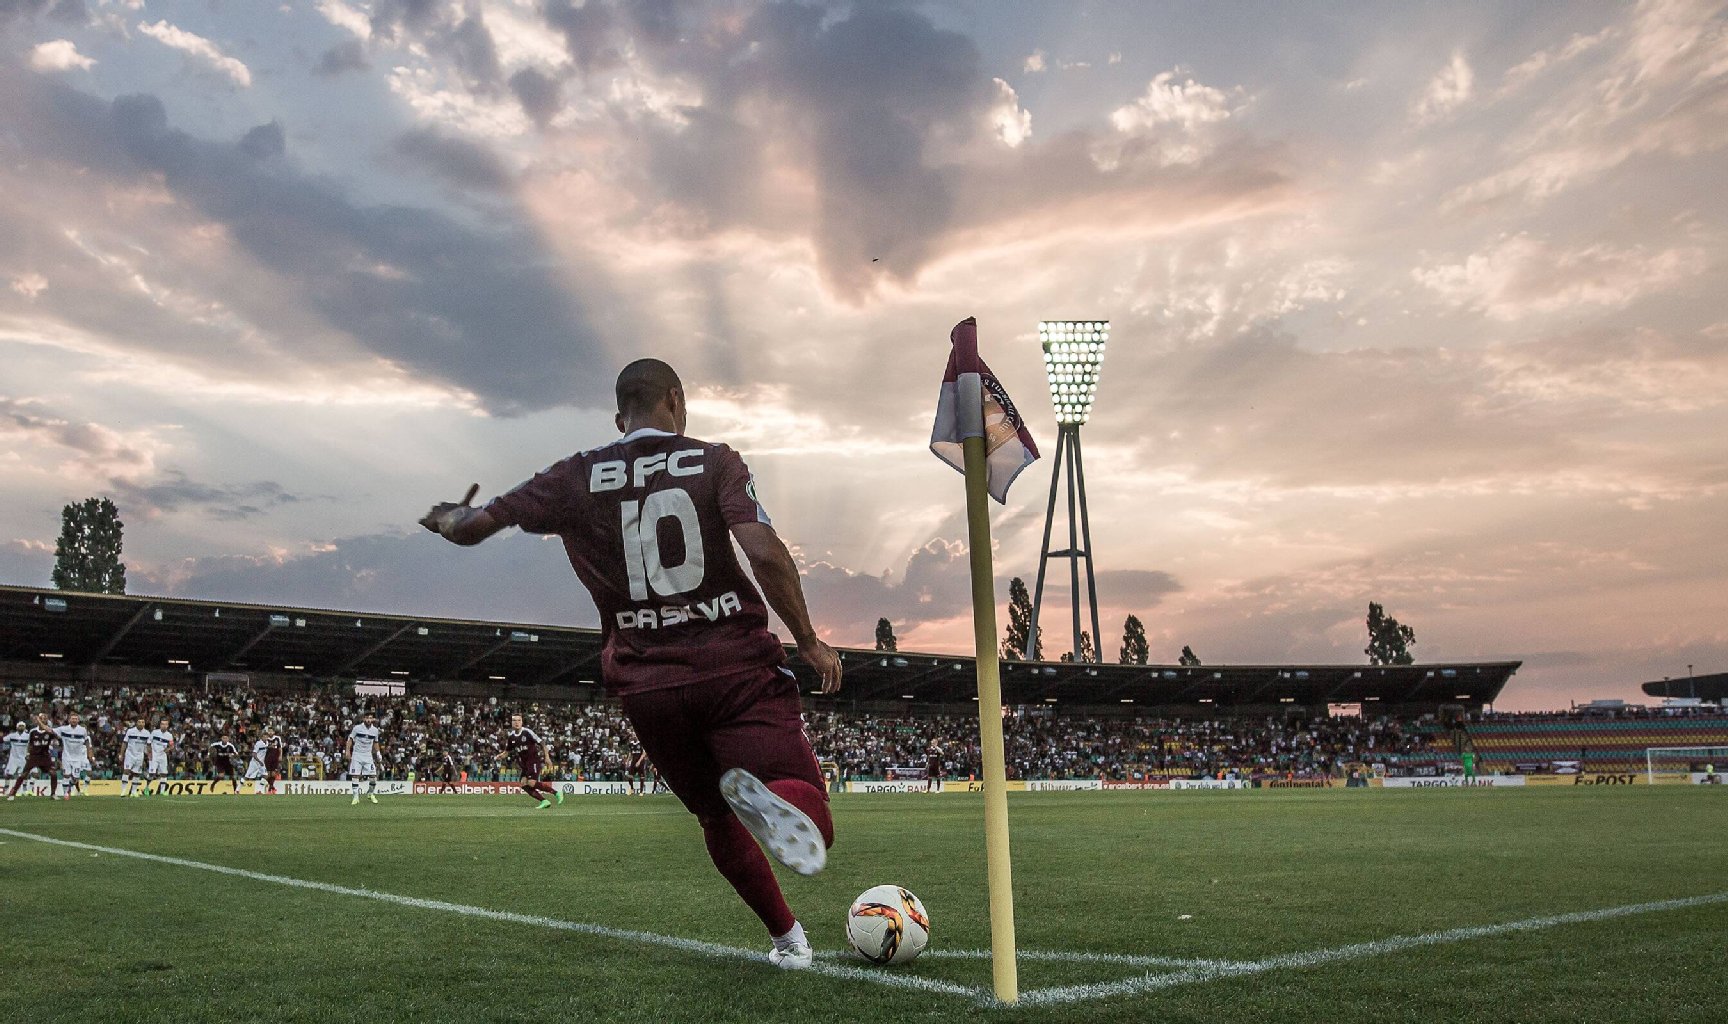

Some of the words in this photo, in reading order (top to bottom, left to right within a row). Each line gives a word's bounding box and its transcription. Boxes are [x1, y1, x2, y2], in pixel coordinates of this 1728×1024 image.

[590, 449, 704, 493] BFC
[621, 488, 705, 601] 10
[585, 784, 602, 794] Der
[606, 784, 626, 794] club
[865, 785, 897, 793] TARGO
